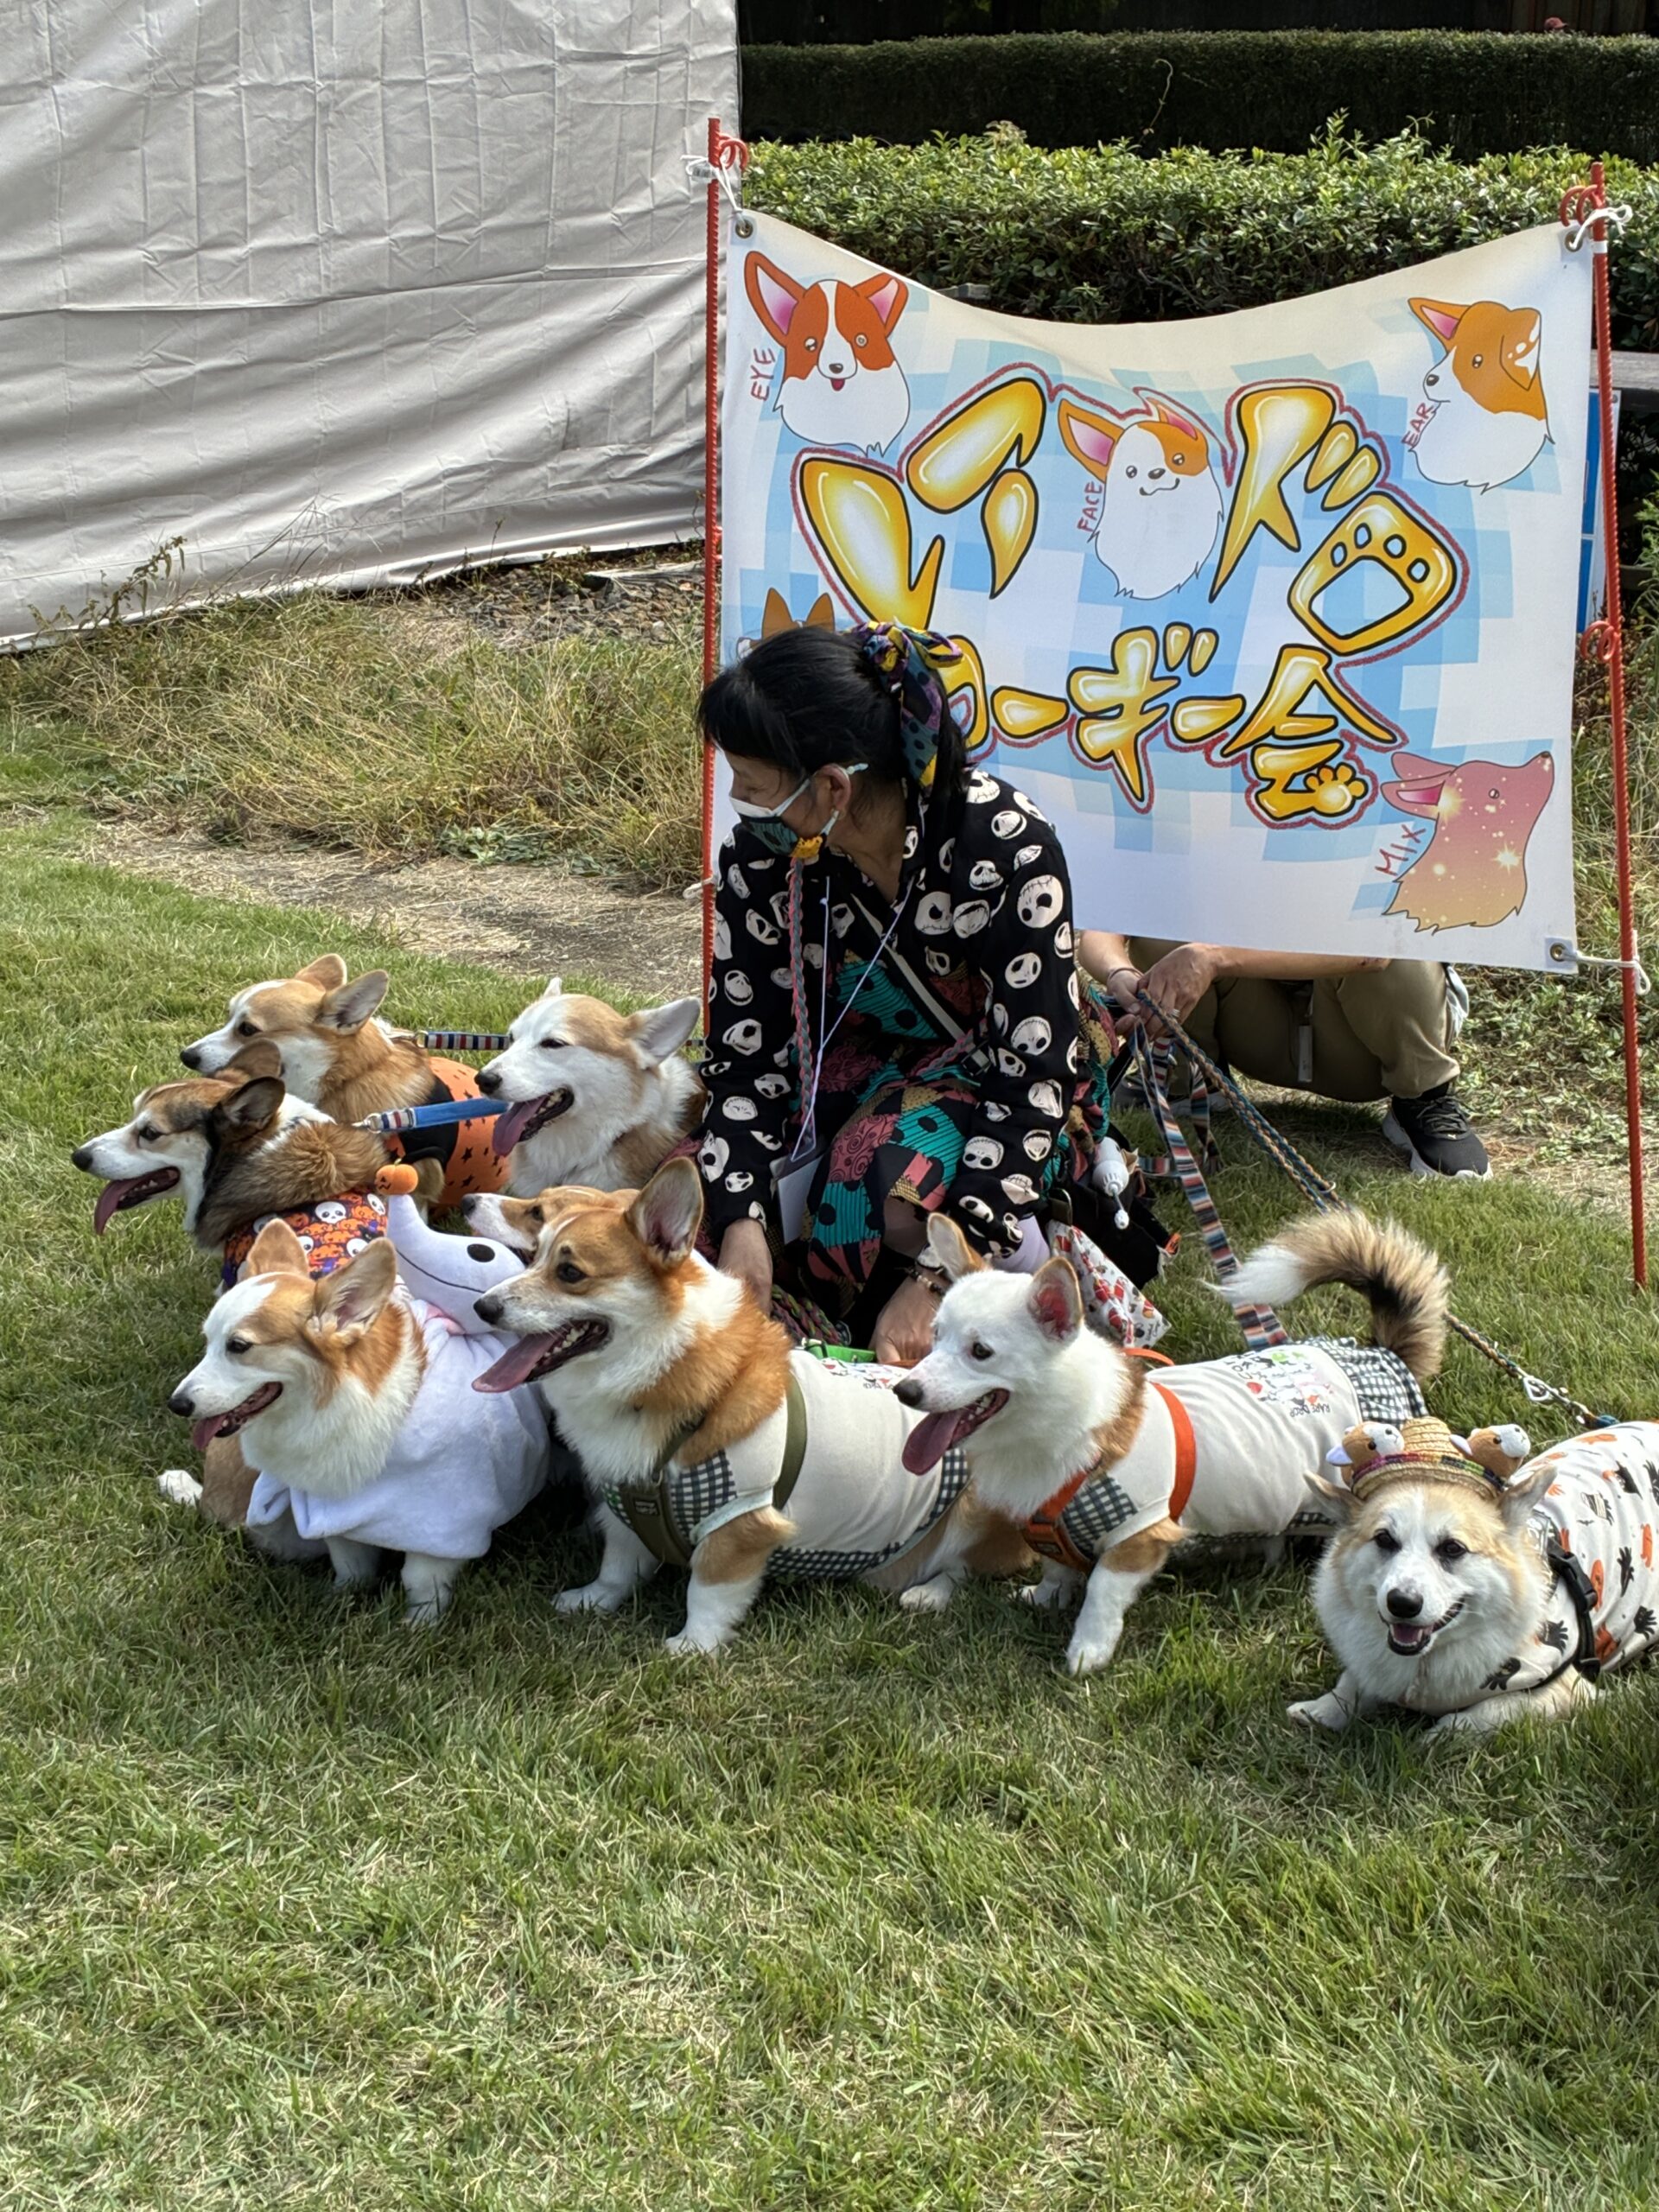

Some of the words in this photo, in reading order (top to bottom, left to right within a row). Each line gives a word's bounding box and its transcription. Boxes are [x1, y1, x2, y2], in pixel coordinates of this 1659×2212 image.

[750, 347, 776, 401] EYE
[1401, 403, 1435, 448] EAR
[1077, 480, 1103, 532] FACE
[1375, 823, 1427, 876] MIX
